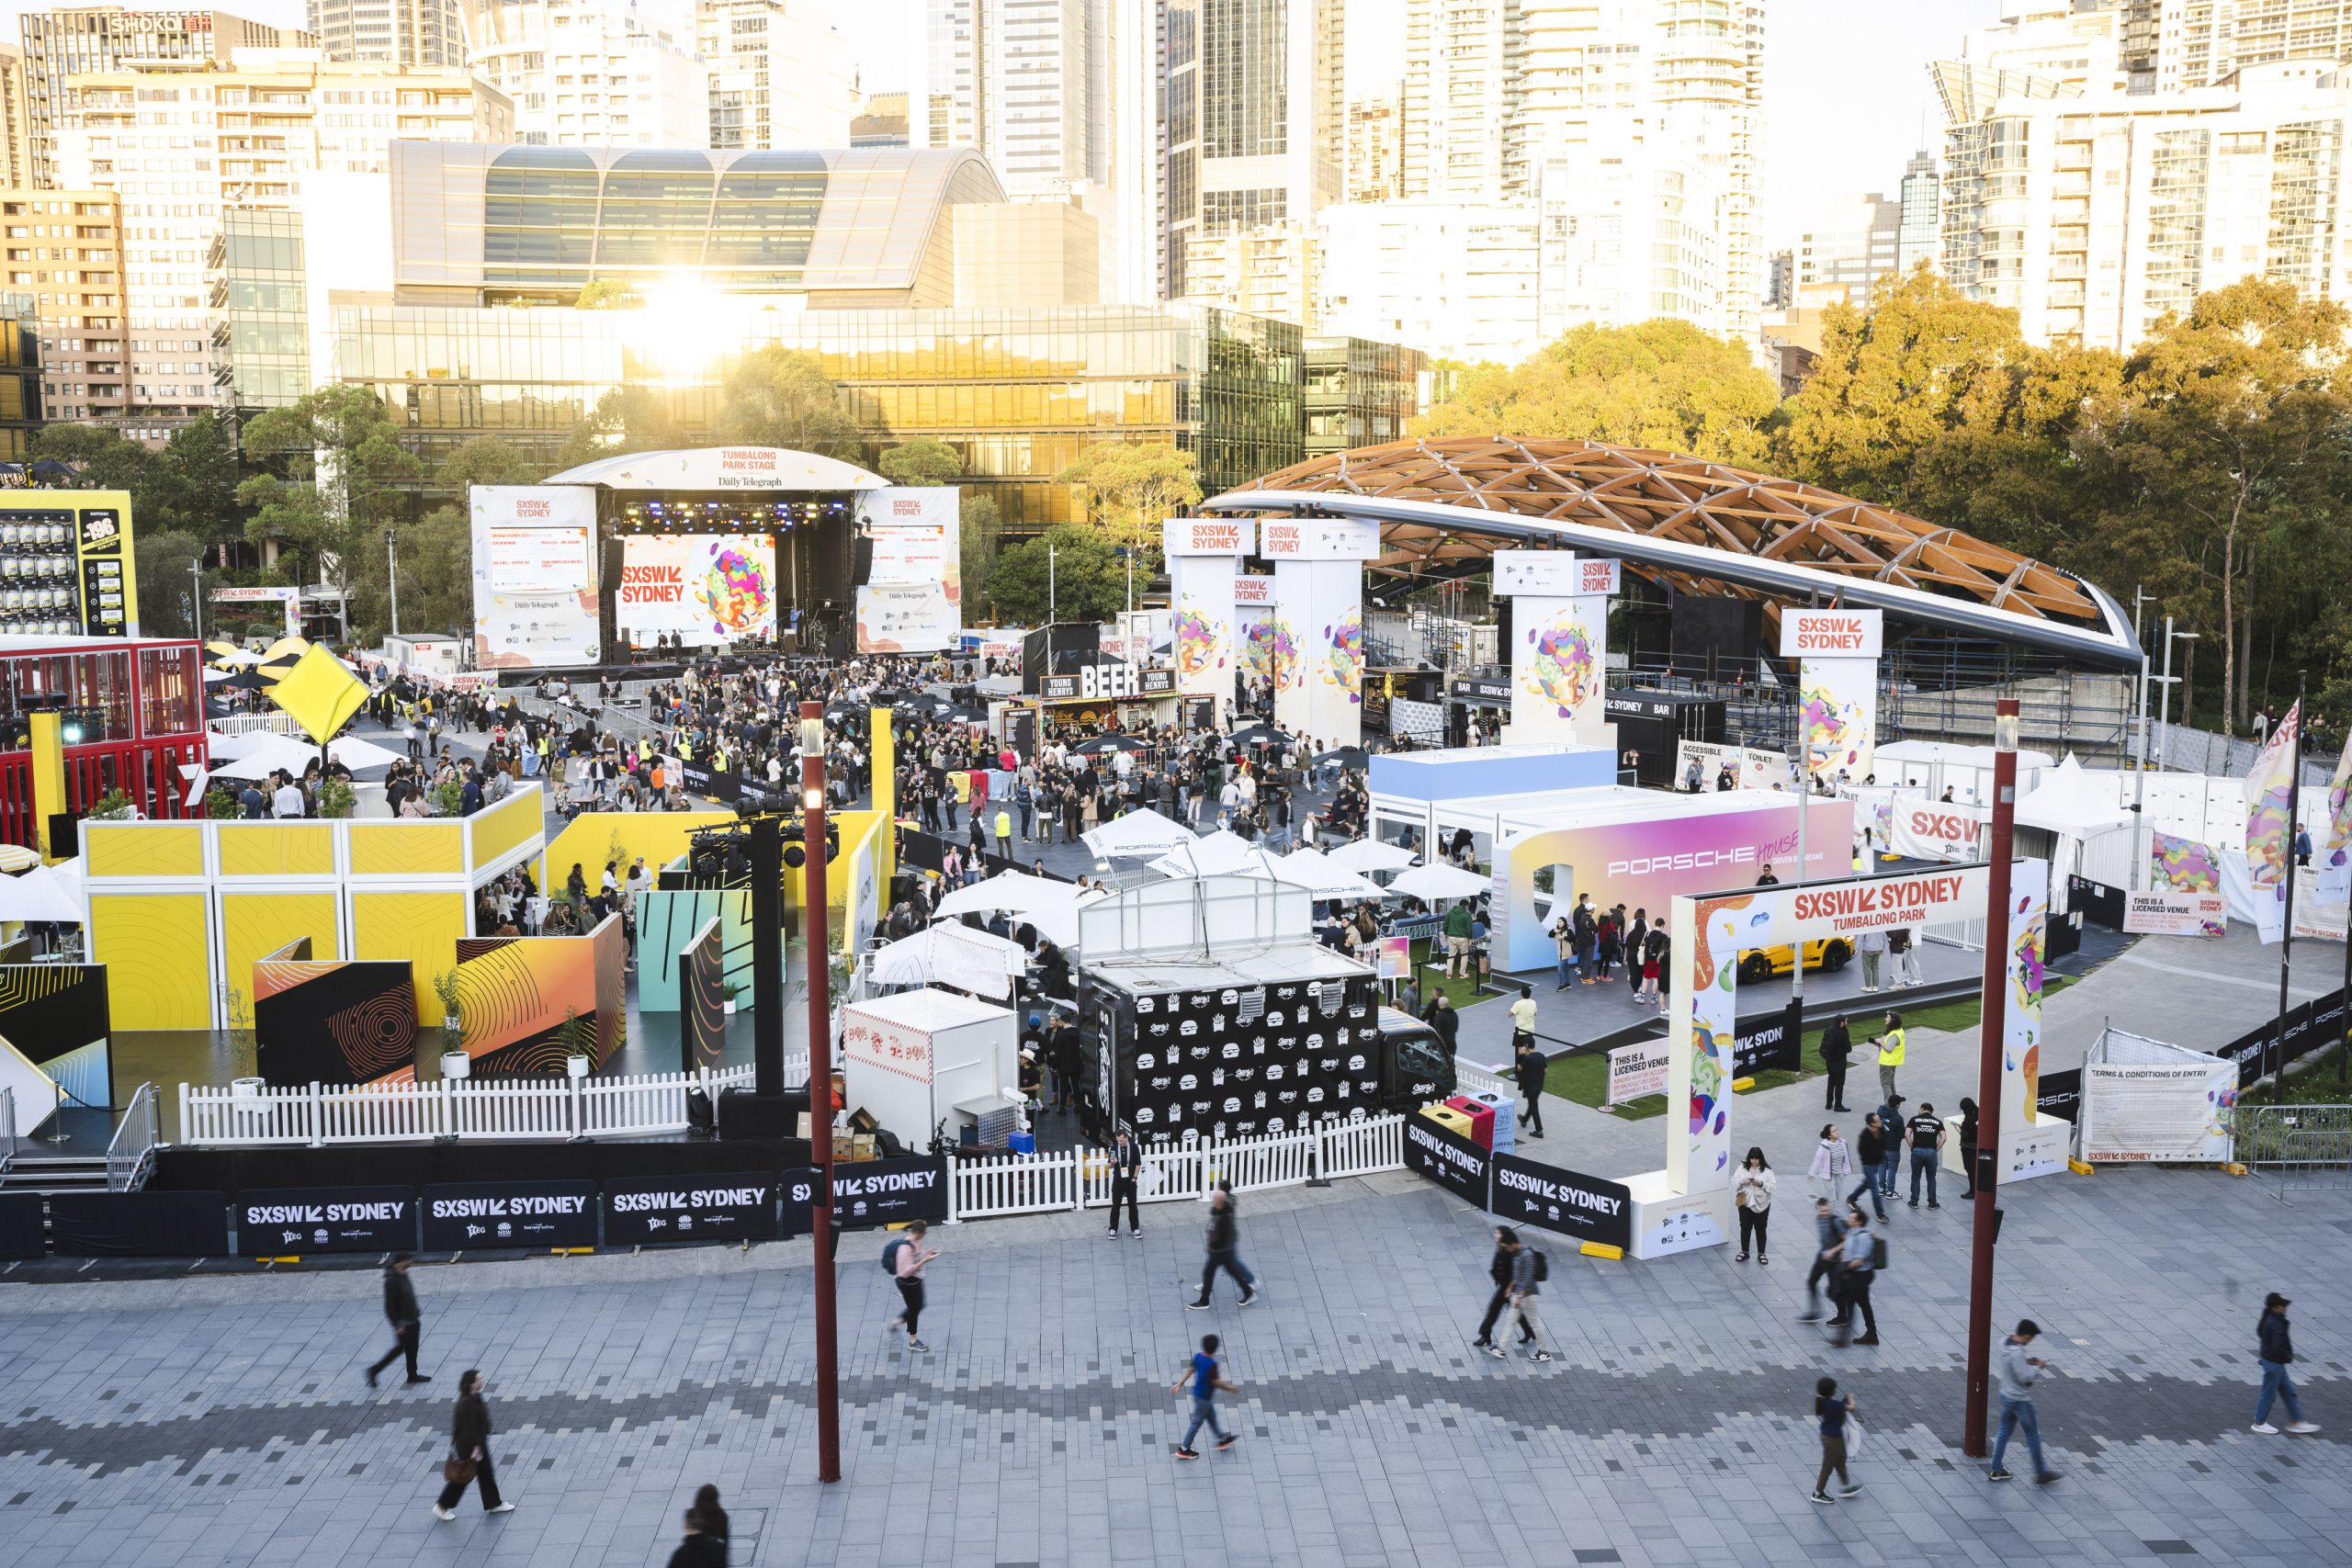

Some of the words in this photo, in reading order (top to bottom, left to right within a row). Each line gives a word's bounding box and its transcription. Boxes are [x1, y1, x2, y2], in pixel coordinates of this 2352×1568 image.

[722, 451, 776, 460] TUMBALONG
[722, 461, 745, 469] PARK
[748, 461, 776, 469] STAGE
[718, 477, 741, 488] Daily
[741, 477, 782, 488] Telegraph
[893, 500, 914, 508] SXSW
[516, 509, 551, 517] SYDNEY
[893, 508, 922, 516] SYDNEY
[1193, 525, 1227, 536] SXSW
[1268, 526, 1292, 538] SXSW
[1193, 537, 1240, 548] SYDNEY
[1268, 540, 1300, 552] SYDNEY
[622, 566, 666, 583] SXSW
[1583, 562, 1604, 577] SXSW
[1583, 577, 1611, 592] SYDNEY
[622, 585, 684, 603] SYDNEY
[514, 601, 530, 609] Daily
[531, 601, 560, 609] Telegraph
[1798, 618, 1846, 633] SXSW
[1797, 634, 1863, 649] SYDNEY
[1050, 678, 1071, 687] YOUNG
[1080, 662, 1139, 699] BEER
[1147, 671, 1168, 681] YOUNG
[1048, 687, 1073, 696] HENRYS
[1145, 681, 1169, 690] HENRYS
[1458, 682, 1471, 693] BAR
[1480, 685, 1498, 695] SXSW
[1614, 699, 1642, 713] SYDNEY
[1654, 704, 1669, 716] BAR
[1682, 744, 1722, 756] ACCESSIBLE
[1748, 752, 1773, 764] TOILET
[1839, 789, 1859, 802] TOILET
[1608, 846, 1755, 878] PORSCHE
[1756, 829, 1799, 867] HOUSE
[1772, 855, 1792, 865] DRIVEN
[1804, 852, 1824, 861] REAMS
[1794, 888, 1856, 920] SXSW
[1881, 876, 1962, 909] SYDNEY
[2133, 897, 2150, 906] THIS
[2132, 905, 2165, 913] LICENSED
[2167, 906, 2189, 914] VENUE
[1833, 911, 1896, 931] TUMBALONG
[1898, 908, 1926, 922] PARK
[2293, 925, 2312, 934] SXSW
[2317, 928, 2344, 938] SYDNEY
[2241, 1040, 2263, 1064] SYDNEY
[1614, 1055, 1631, 1066] THIS
[1631, 1054, 1638, 1063] IS
[1639, 1052, 1645, 1061] A
[1614, 1061, 1646, 1077] LICENSED
[1647, 1056, 1669, 1069] VENUE
[2092, 1069, 2117, 1077] TERMS
[2118, 1070, 2124, 1078] &
[2125, 1070, 2171, 1078] CONDITIONS
[2183, 1069, 2208, 1077] ENTRY
[1408, 1123, 1436, 1153] SXSW
[1444, 1144, 1484, 1177] SYDNEY
[2088, 1153, 2112, 1161] SXSW
[2120, 1152, 2153, 1160] SYDNEY
[865, 1170, 937, 1193] SYDNEY
[1499, 1168, 1543, 1194] SXSW
[1558, 1186, 1621, 1216] SYDNEY
[433, 1199, 488, 1218] SXSW
[510, 1196, 586, 1215] SYDNEY
[614, 1191, 669, 1213] SXSW
[690, 1188, 765, 1208] SYDNEY
[247, 1205, 304, 1224] SXSW
[326, 1201, 404, 1222] SYDNEY
[833, 1206, 842, 1214] EG
